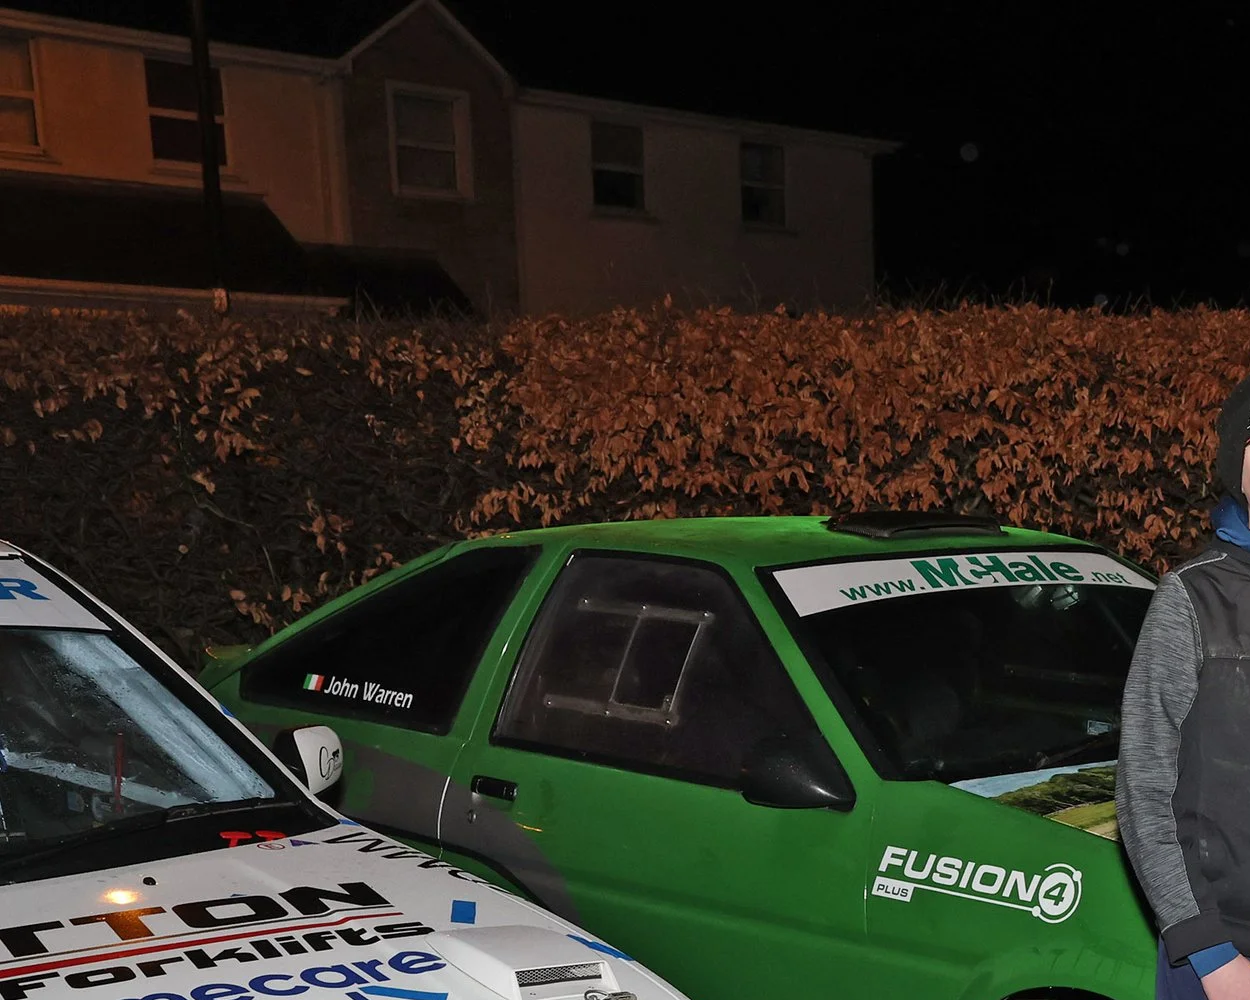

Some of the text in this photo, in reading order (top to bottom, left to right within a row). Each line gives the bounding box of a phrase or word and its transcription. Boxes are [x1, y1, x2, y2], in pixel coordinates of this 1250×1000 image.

[324, 676, 413, 709] John Warren
[876, 883, 909, 898] PLUS
